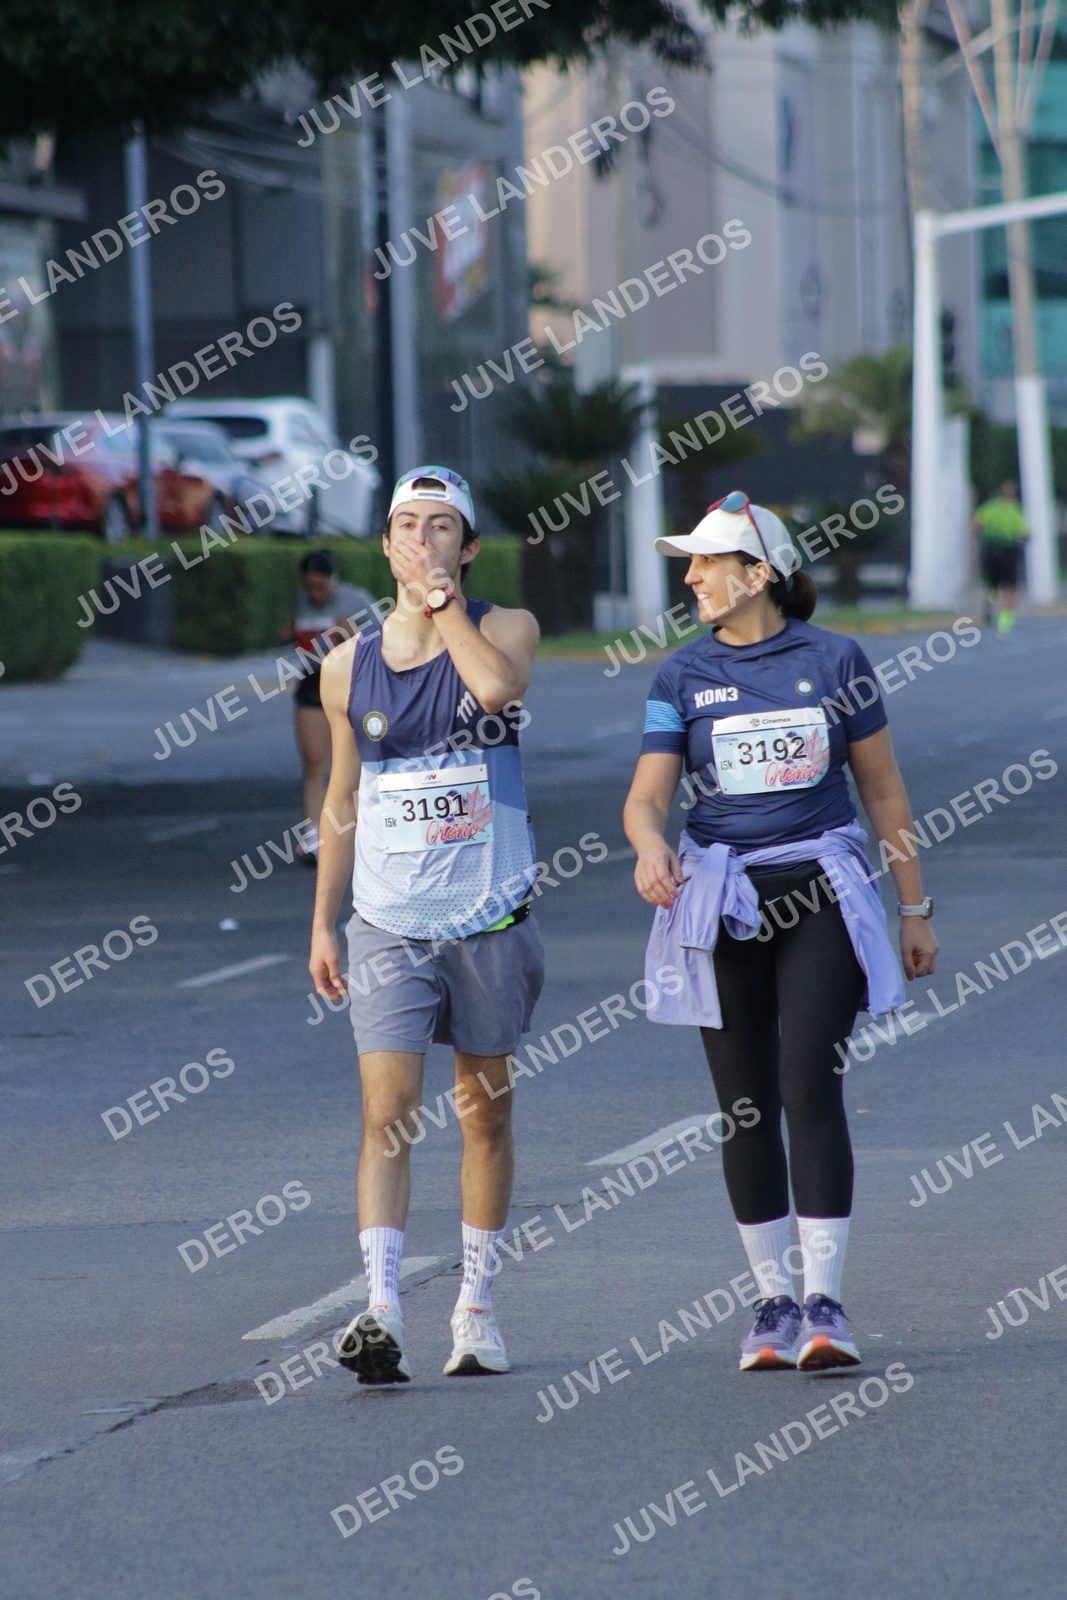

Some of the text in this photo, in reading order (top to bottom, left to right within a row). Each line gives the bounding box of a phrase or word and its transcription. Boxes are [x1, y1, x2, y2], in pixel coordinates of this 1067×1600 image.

[694, 687, 738, 708] KON3
[738, 736, 807, 765] 3192
[402, 794, 468, 822] 3191
